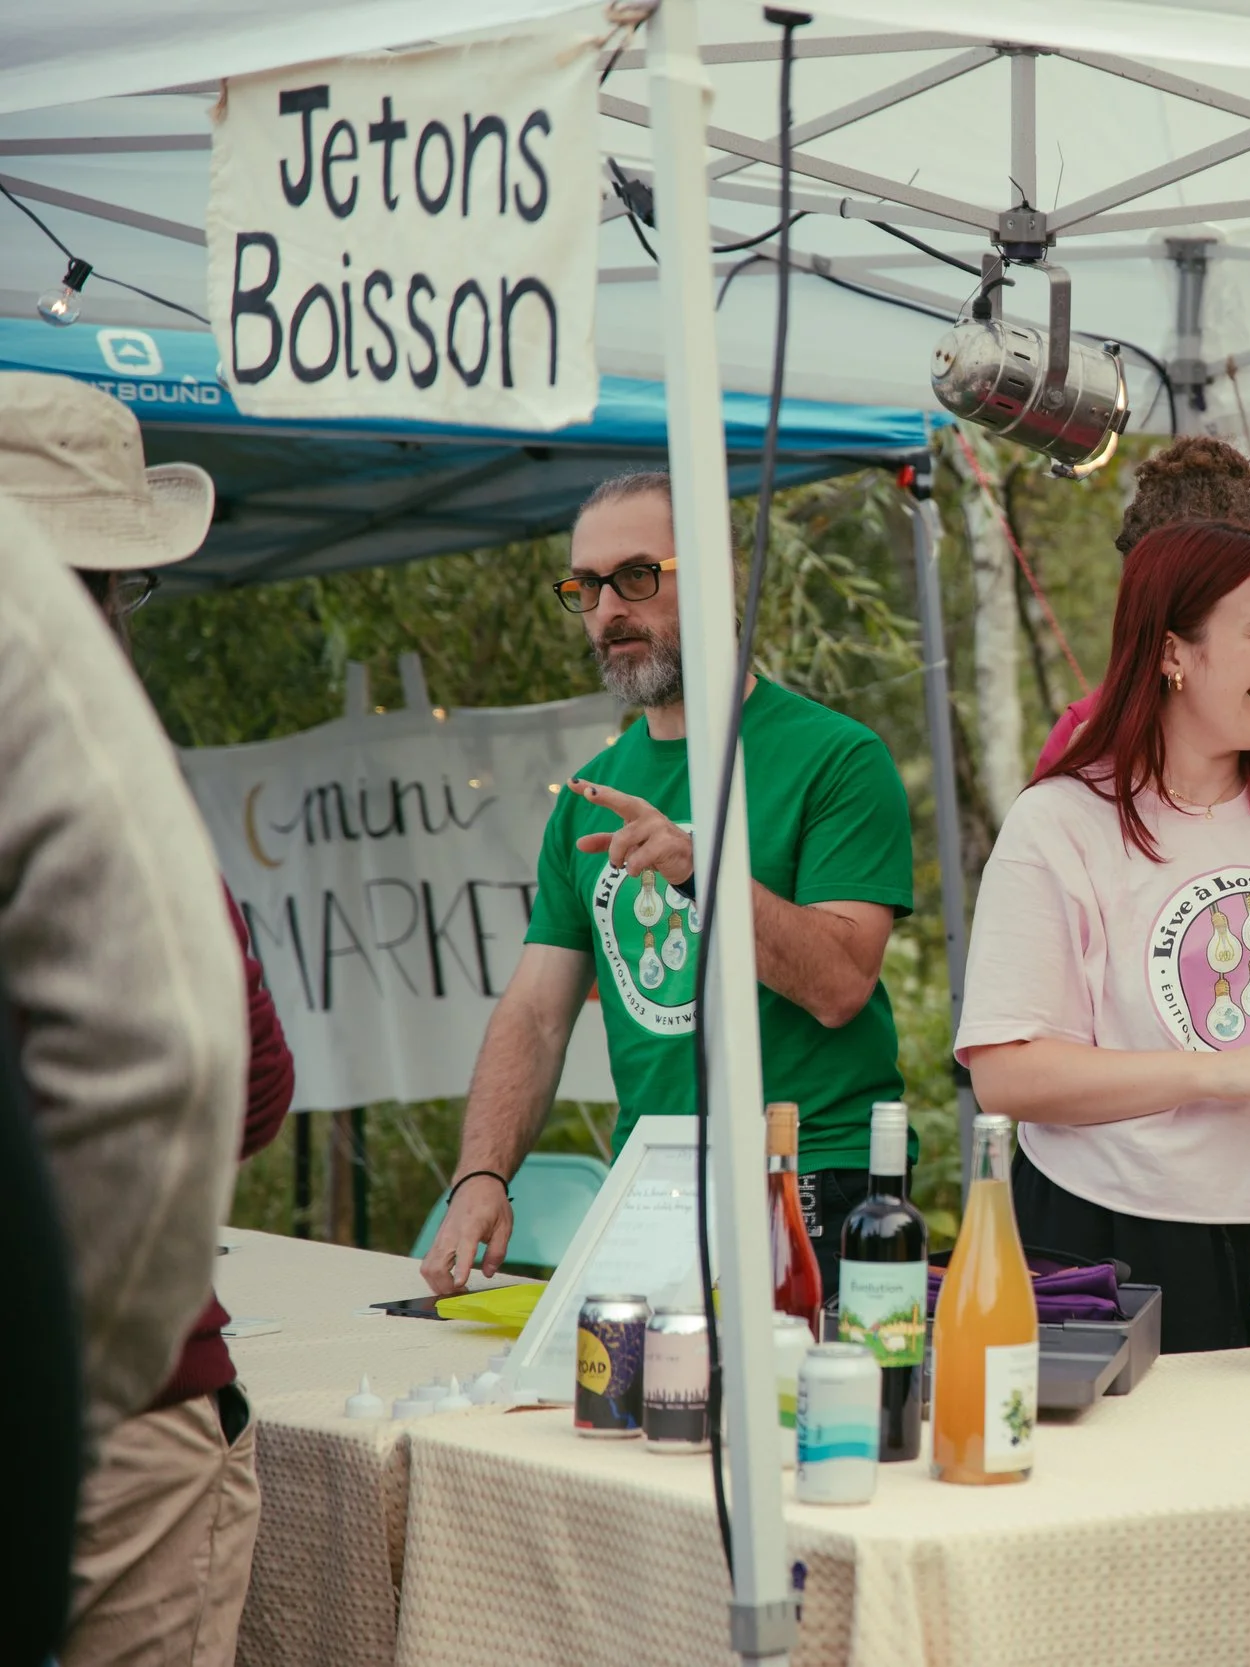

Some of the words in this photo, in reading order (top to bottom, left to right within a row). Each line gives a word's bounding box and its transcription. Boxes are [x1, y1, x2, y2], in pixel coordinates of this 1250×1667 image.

[279, 84, 552, 222] Jetons
[231, 231, 557, 389] Boisson
[270, 775, 499, 847] mini
[1153, 900, 1193, 959] Live
[1195, 885, 1213, 901] à
